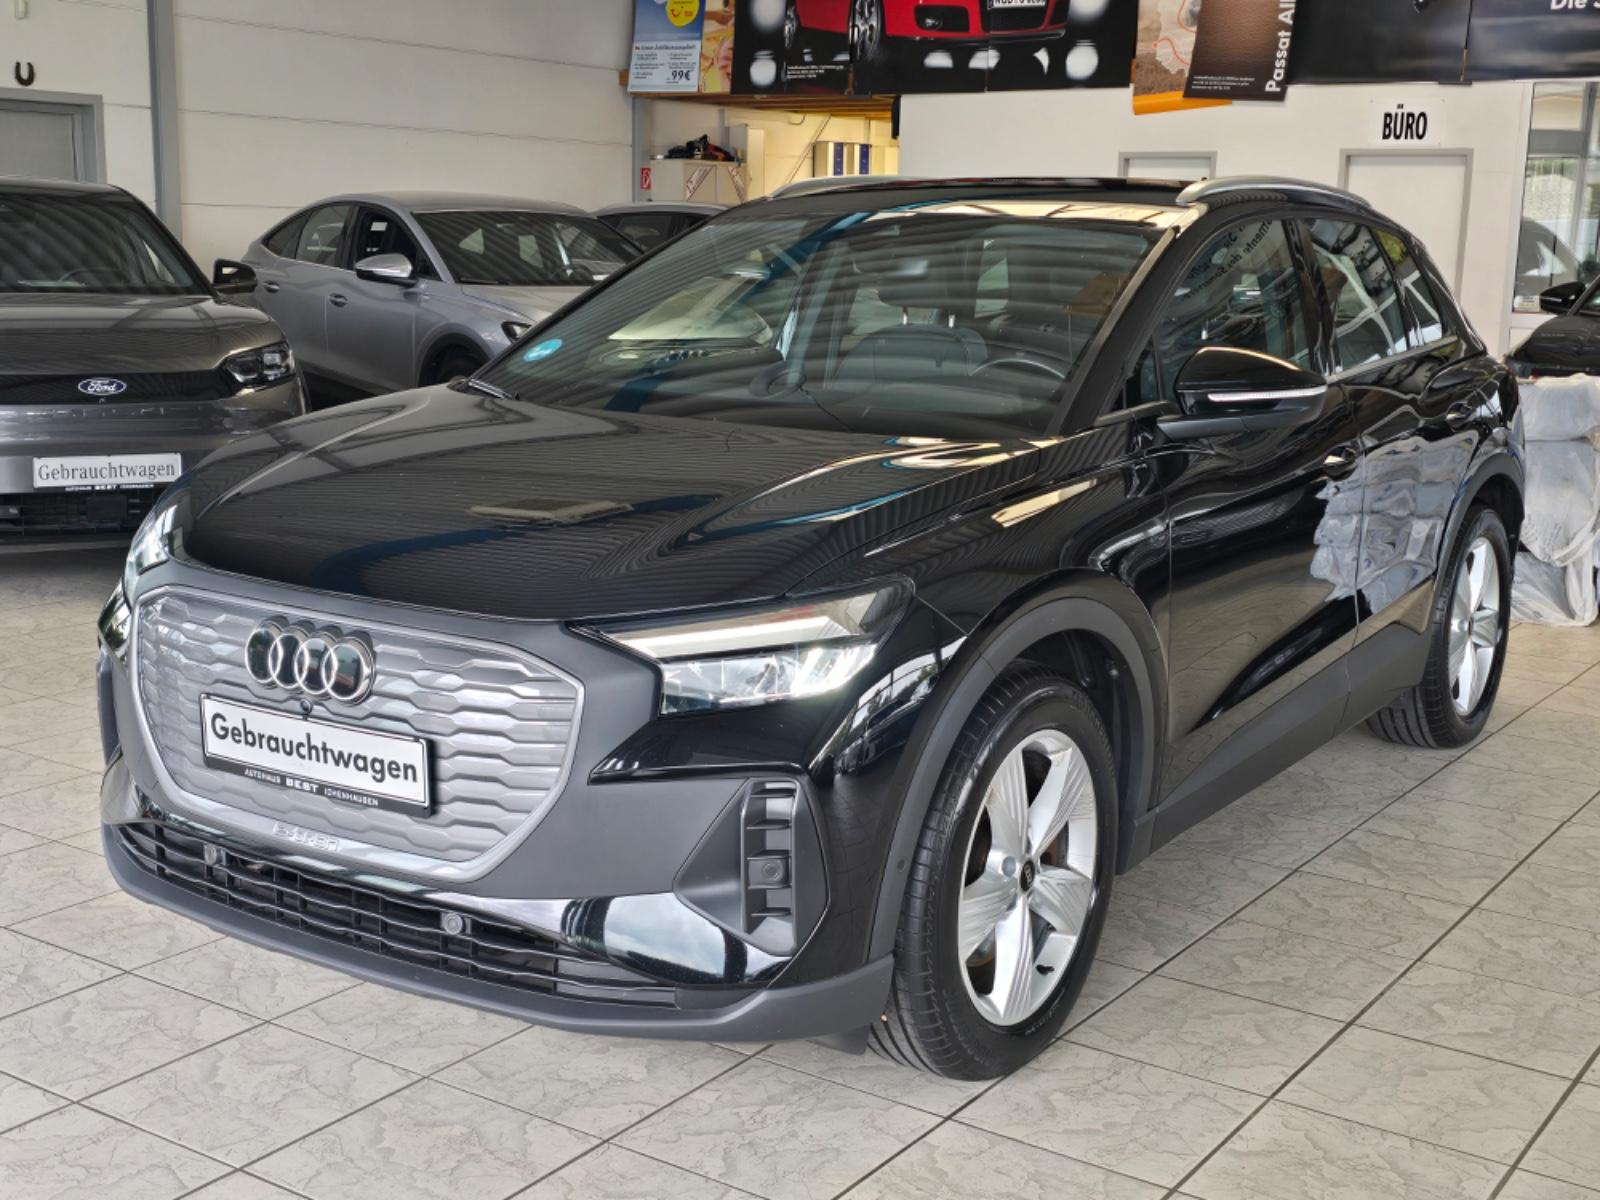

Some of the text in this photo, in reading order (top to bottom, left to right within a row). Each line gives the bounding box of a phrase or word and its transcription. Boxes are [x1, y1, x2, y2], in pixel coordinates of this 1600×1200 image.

[1264, 30, 1292, 92] Passat
[1382, 103, 1428, 140] BÜRO
[88, 380, 117, 393] Ford
[38, 461, 176, 481] Gebrauchtwagen
[211, 712, 418, 783] Gebrauchtwagen
[244, 768, 281, 784] AUTOHAUS
[286, 778, 319, 793] BEST
